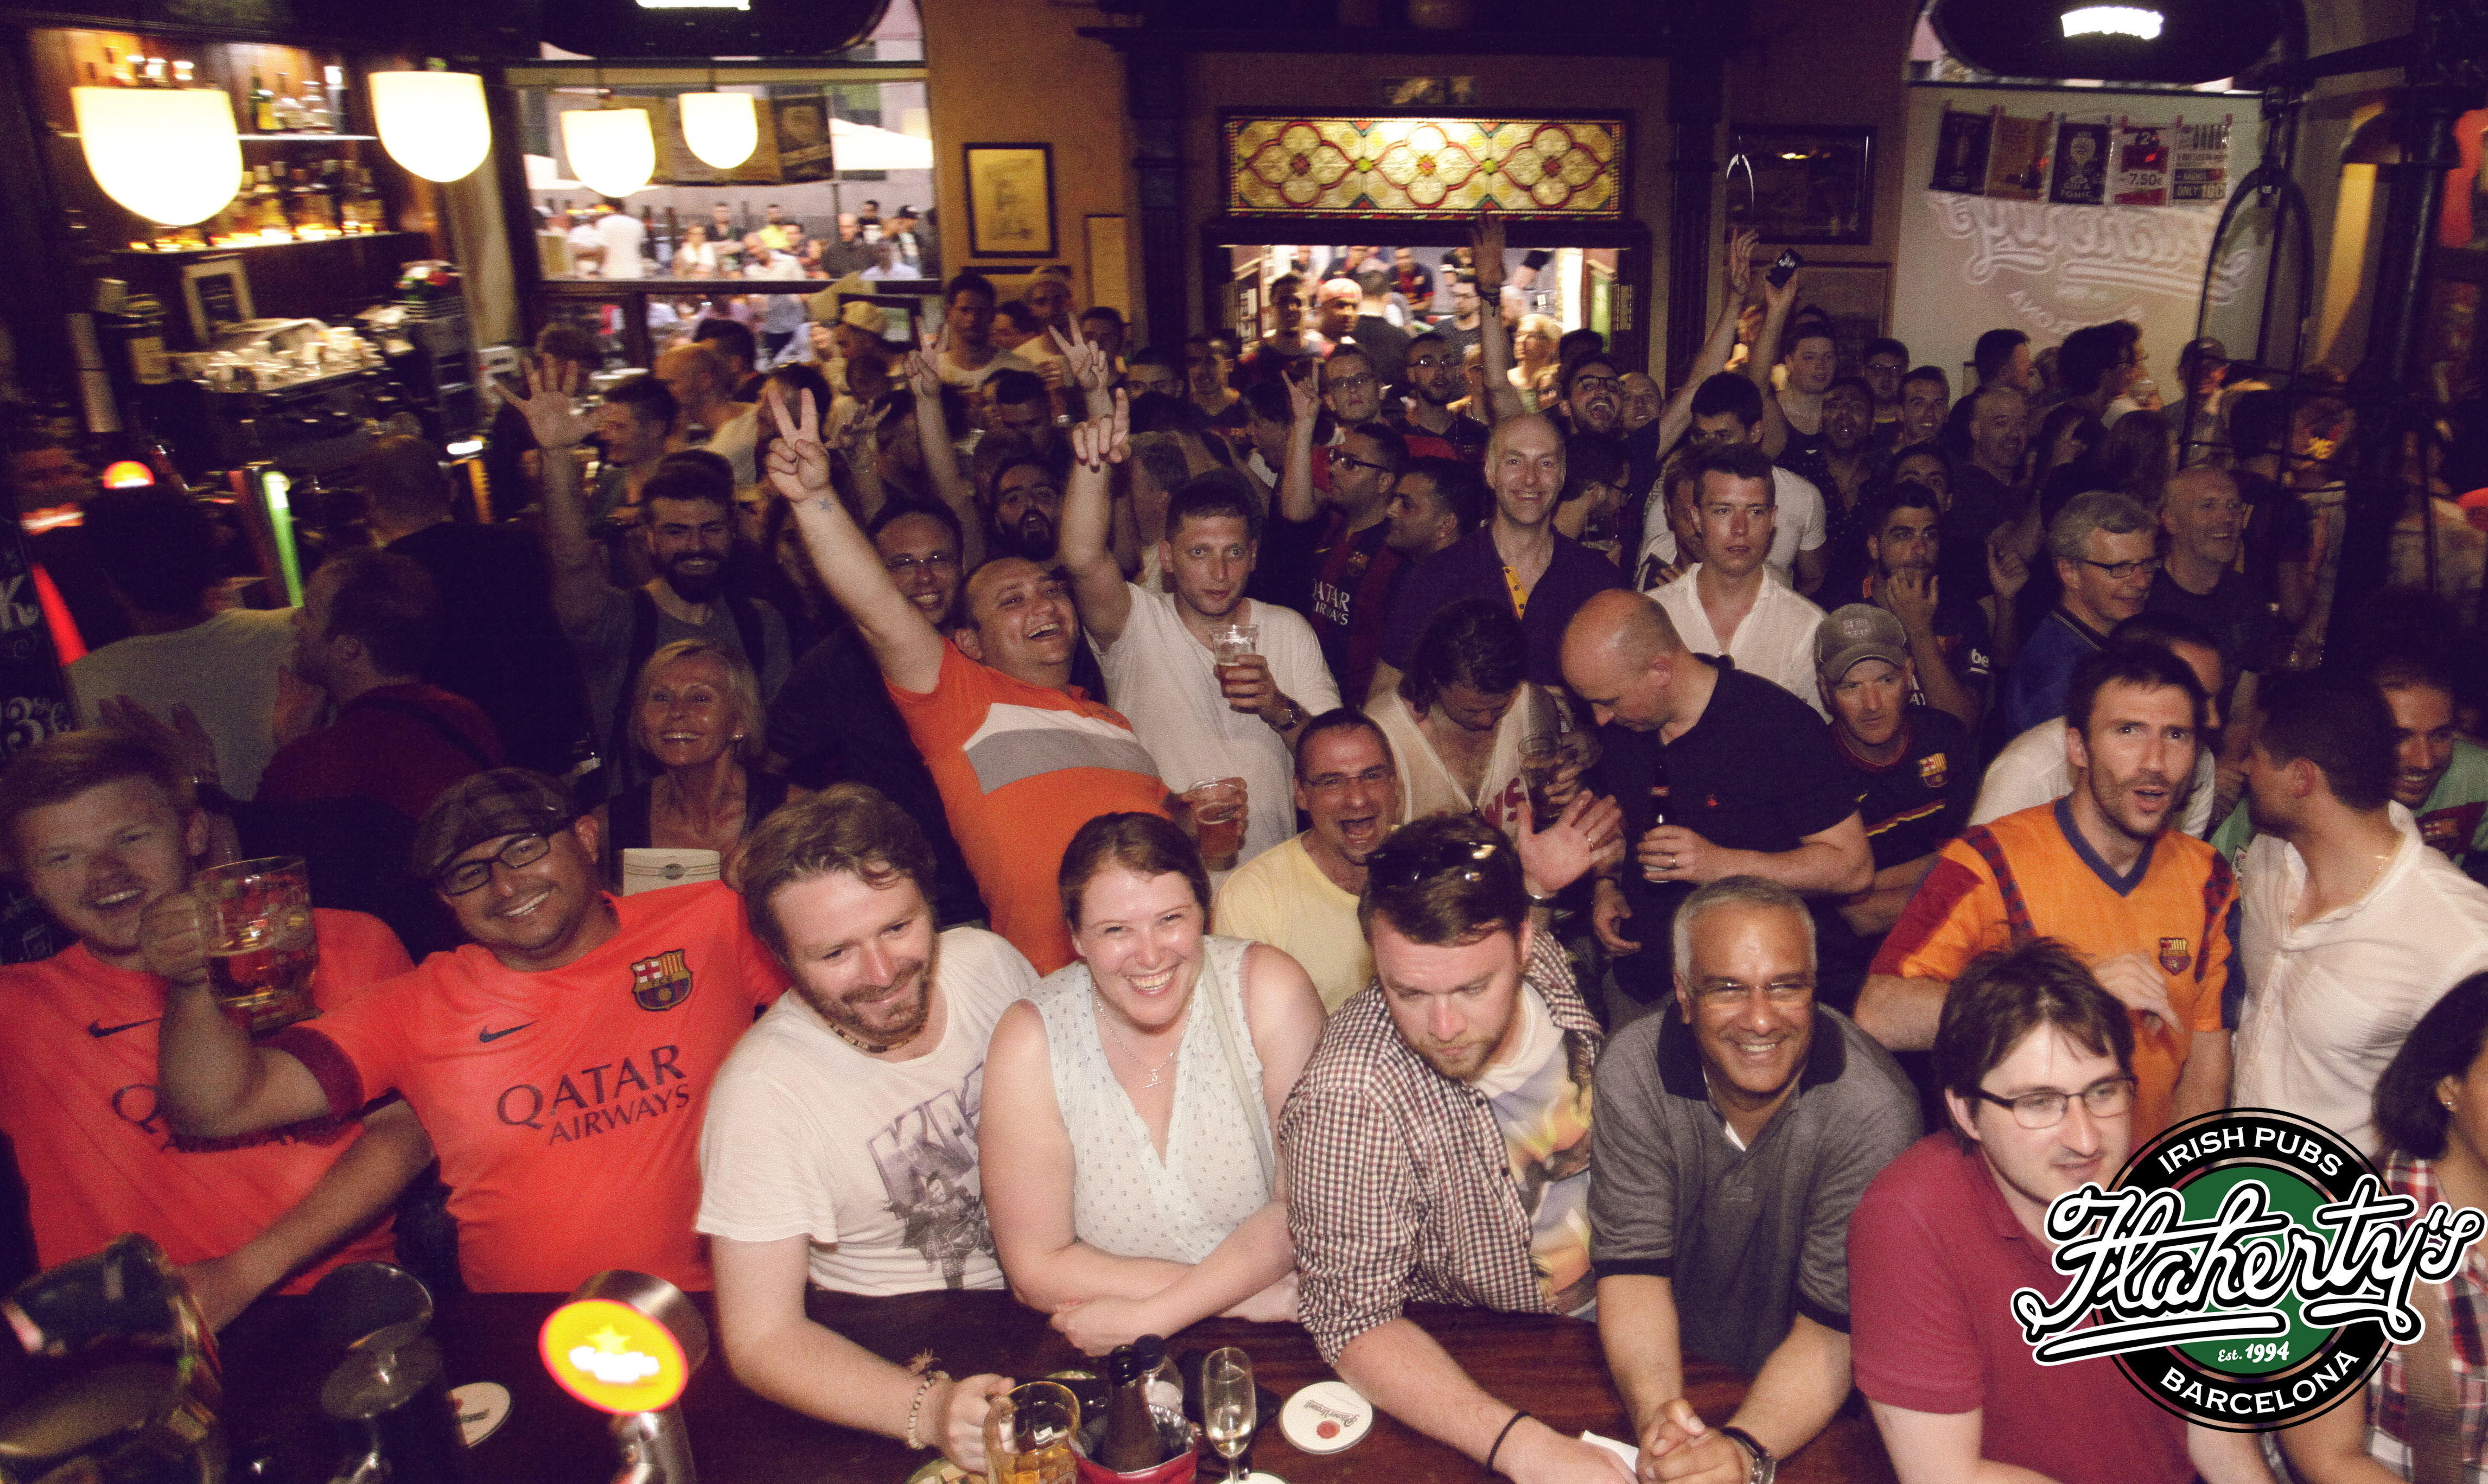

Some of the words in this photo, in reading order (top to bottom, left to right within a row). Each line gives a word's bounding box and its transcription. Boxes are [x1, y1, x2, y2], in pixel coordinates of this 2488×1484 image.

[1313, 601, 1349, 625] IRWAYS
[497, 1045, 686, 1130] QATAR
[549, 1084, 690, 1146] AIRWAYS
